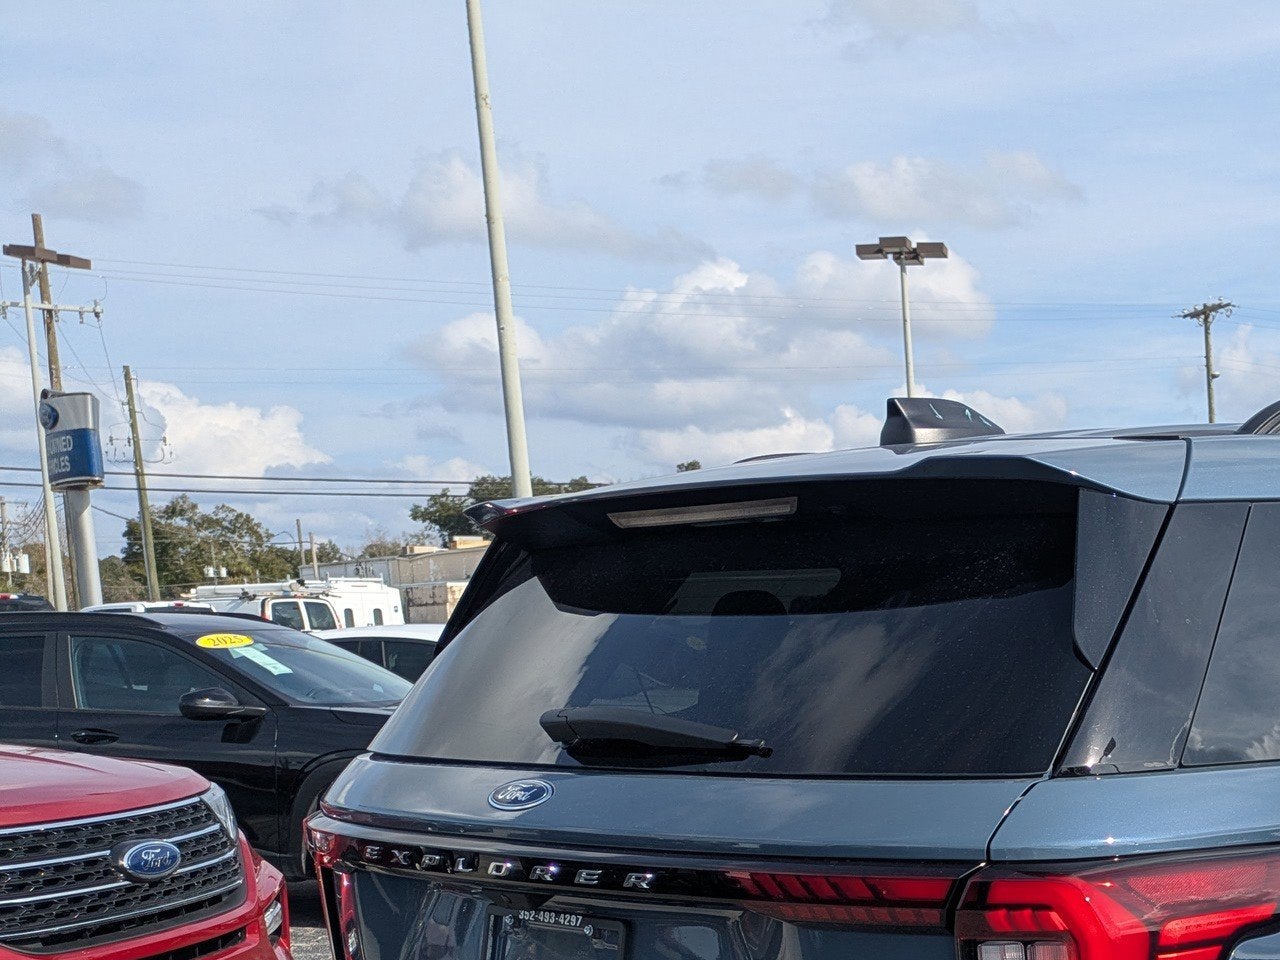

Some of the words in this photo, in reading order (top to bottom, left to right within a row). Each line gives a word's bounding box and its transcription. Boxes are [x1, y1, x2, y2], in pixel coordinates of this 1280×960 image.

[206, 636, 244, 647] 2025
[498, 783, 537, 802] Ford
[141, 848, 172, 870] Ford
[365, 845, 653, 889] EXPLORER
[518, 909, 583, 927] 352-493-4297
